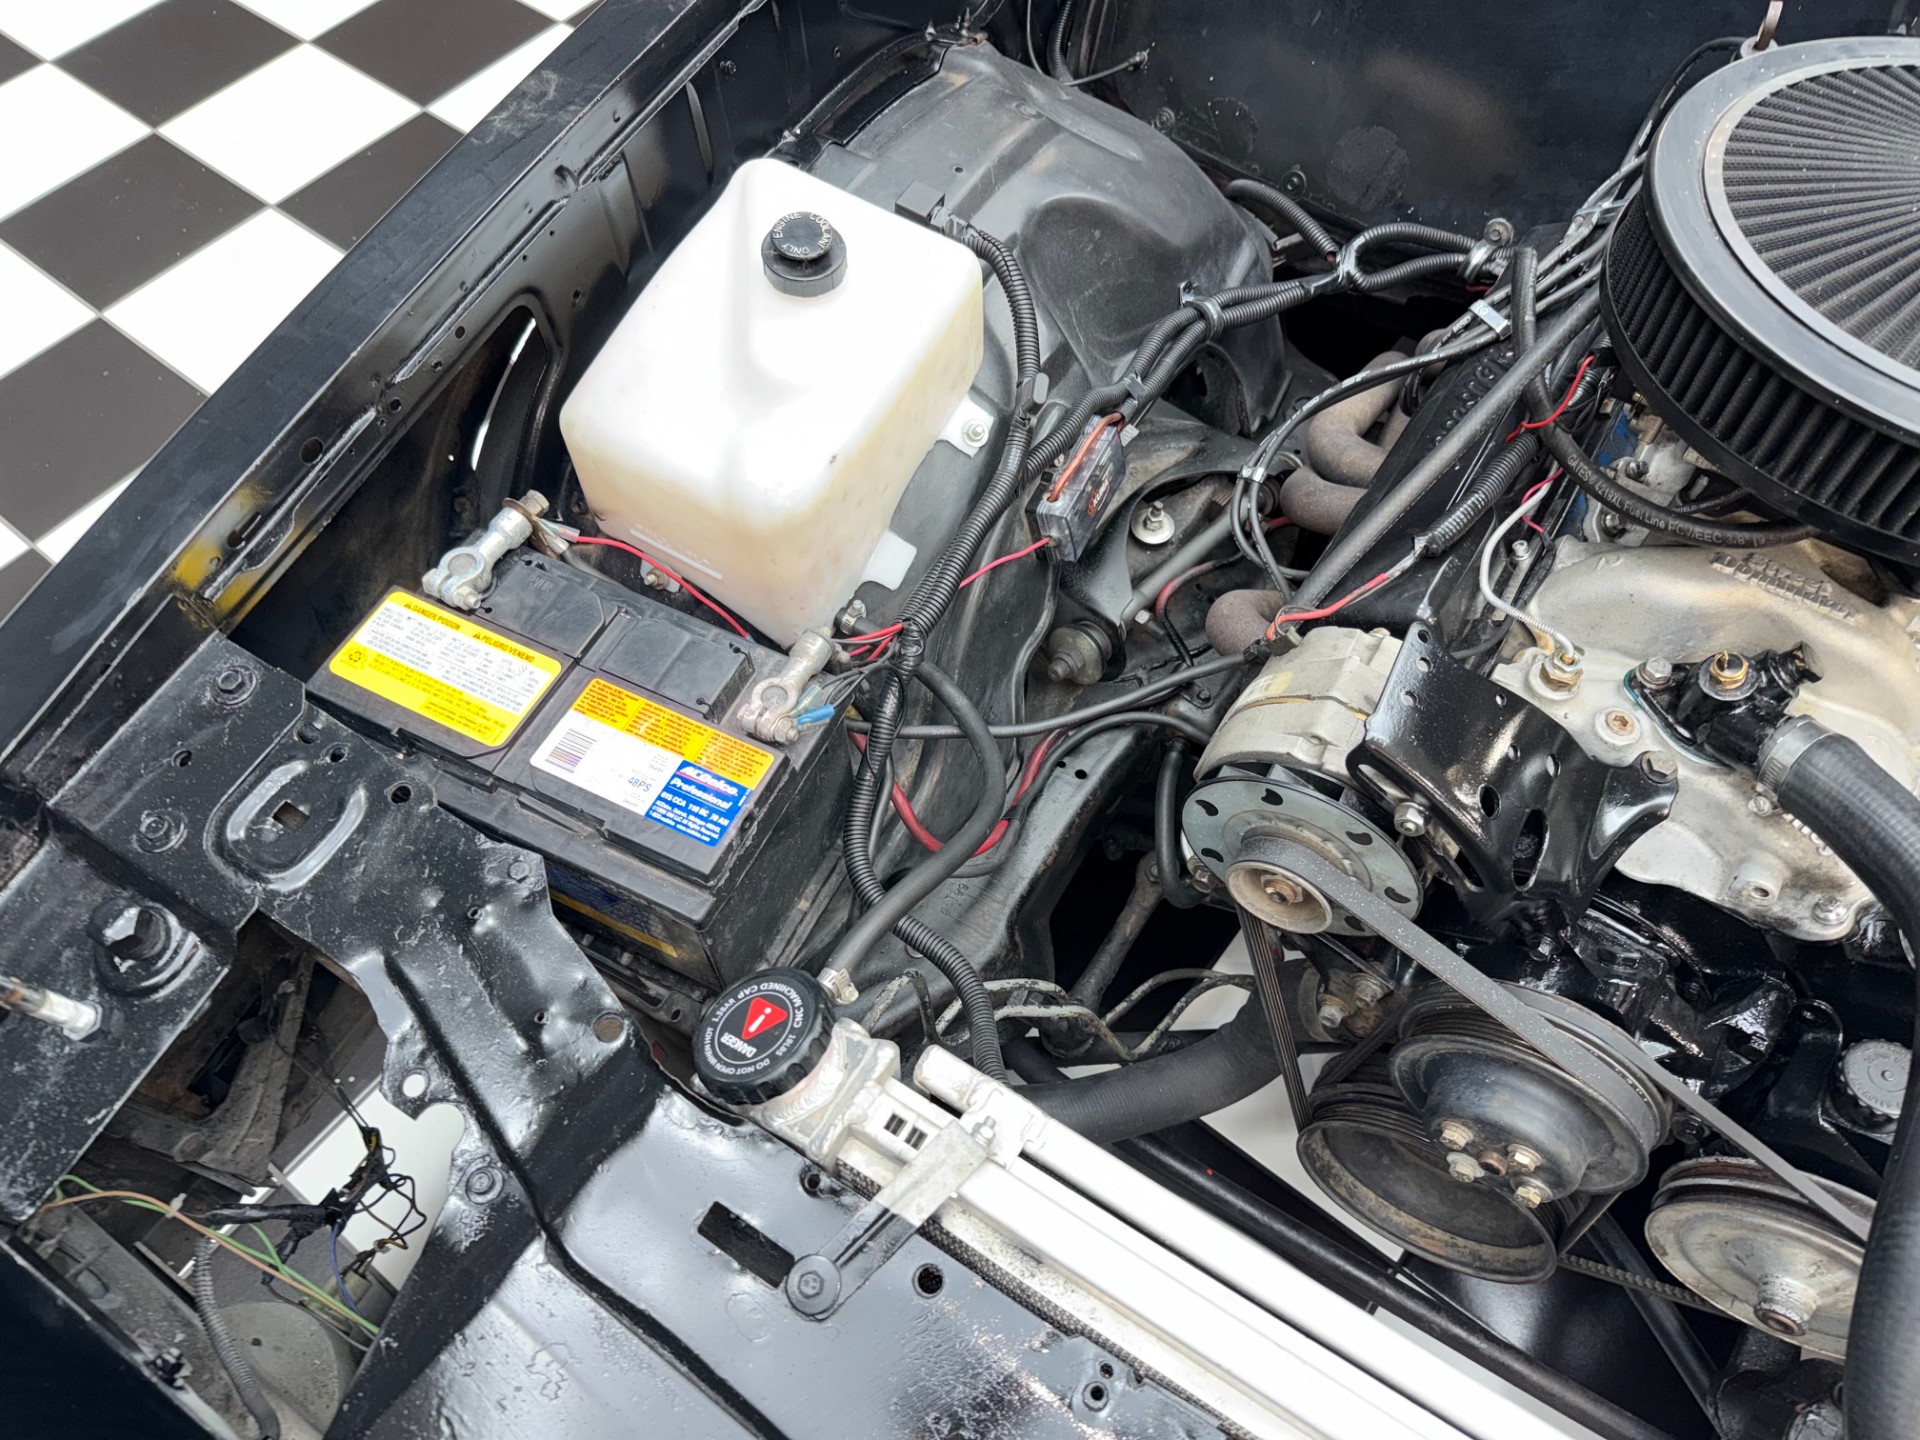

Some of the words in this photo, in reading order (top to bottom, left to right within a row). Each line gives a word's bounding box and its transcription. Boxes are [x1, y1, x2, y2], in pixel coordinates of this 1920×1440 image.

[773, 212, 801, 238] ENGINE
[810, 213, 832, 248] COOLANT
[782, 243, 809, 255] ONLY
[1452, 315, 1471, 333] MSD
[1594, 476, 1623, 509] 4219XL
[1623, 502, 1646, 522] Fuel
[1645, 512, 1666, 530] Line
[1668, 521, 1722, 544] PCV/EEC
[1743, 552, 1834, 598] Street
[1710, 552, 1864, 625] Dominator
[628, 776, 652, 793] 48PS
[679, 766, 738, 795] ACDelco
[670, 778, 733, 810] Professional
[660, 791, 672, 800] 615
[672, 796, 686, 807] CCA
[698, 807, 709, 817] RC
[717, 817, 730, 826] AH
[737, 984, 758, 998] CAP
[760, 982, 803, 1006] MACHINED
[711, 998, 736, 1022] 1.3BAR
[793, 1007, 804, 1028] CNC
[704, 1027, 713, 1043] HOT
[720, 1032, 757, 1058] DANGER
[775, 1034, 796, 1056] 19LBS
[704, 1043, 718, 1066] WHEN
[756, 1058, 770, 1070] DO
[714, 1063, 735, 1074] OPEN
[735, 1065, 755, 1075] NOT
